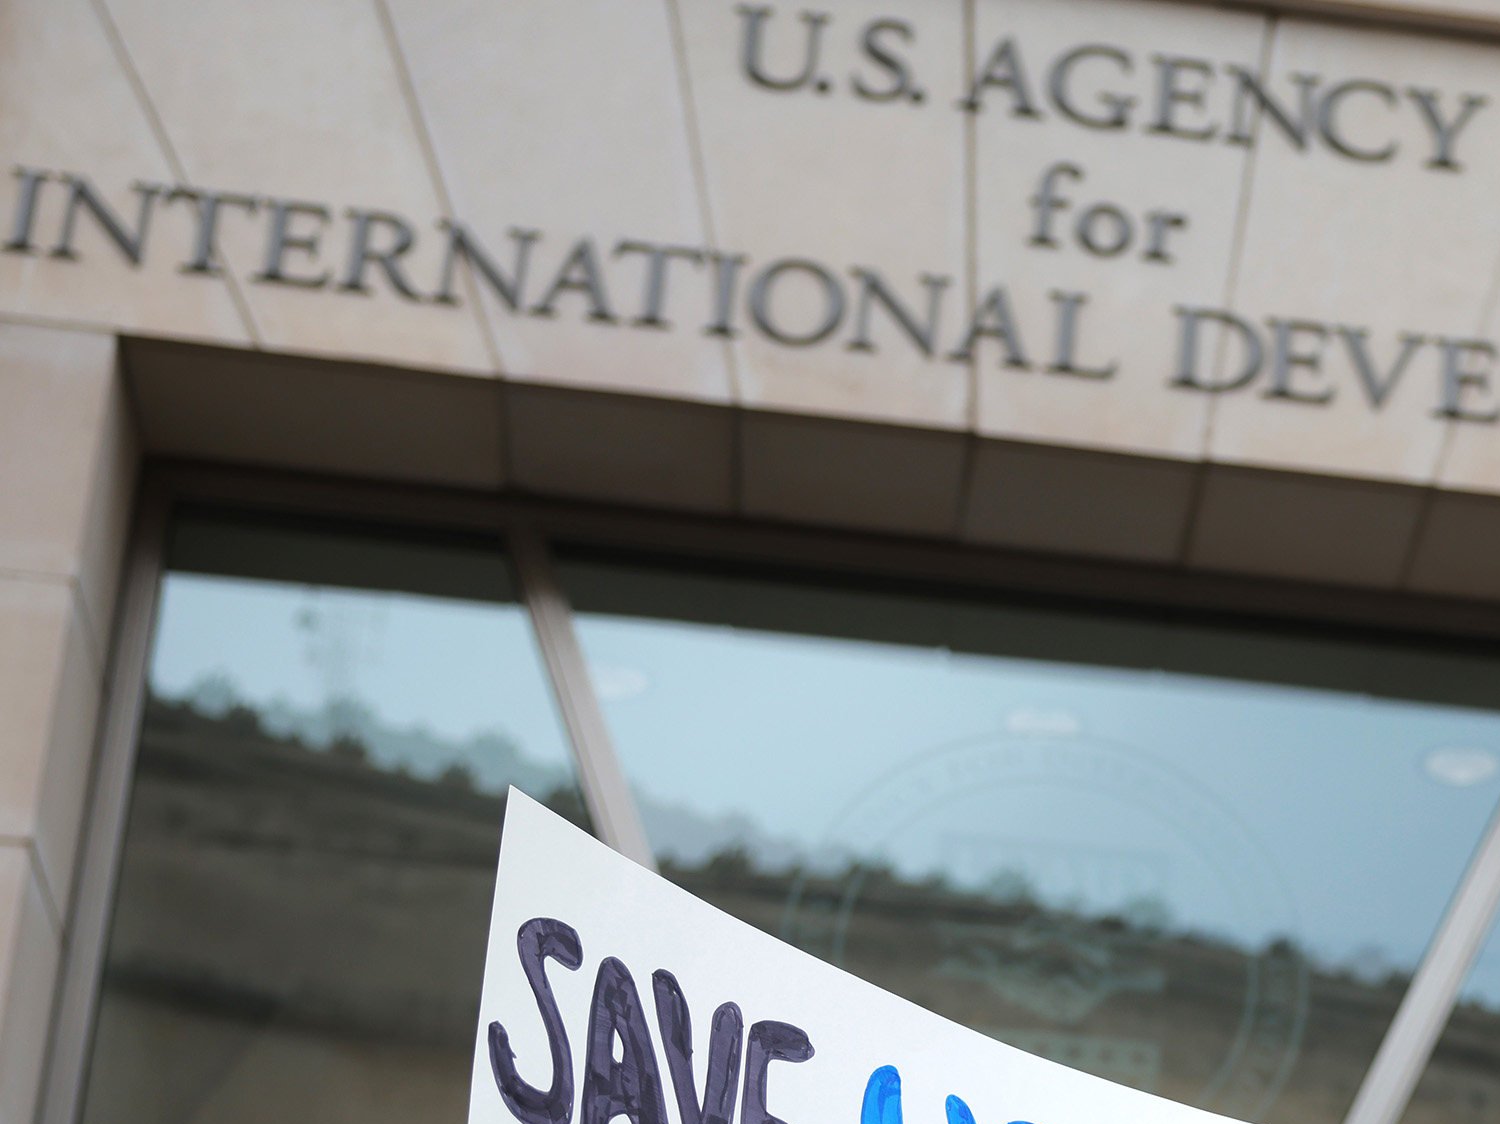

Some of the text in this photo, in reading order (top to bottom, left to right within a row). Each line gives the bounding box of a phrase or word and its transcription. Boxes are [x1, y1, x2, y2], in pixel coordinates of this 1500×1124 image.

[735, 4, 1489, 174] U.S. AGENCY
[2, 166, 1118, 380] INTERNATIONAL
[1026, 161, 1190, 266] for
